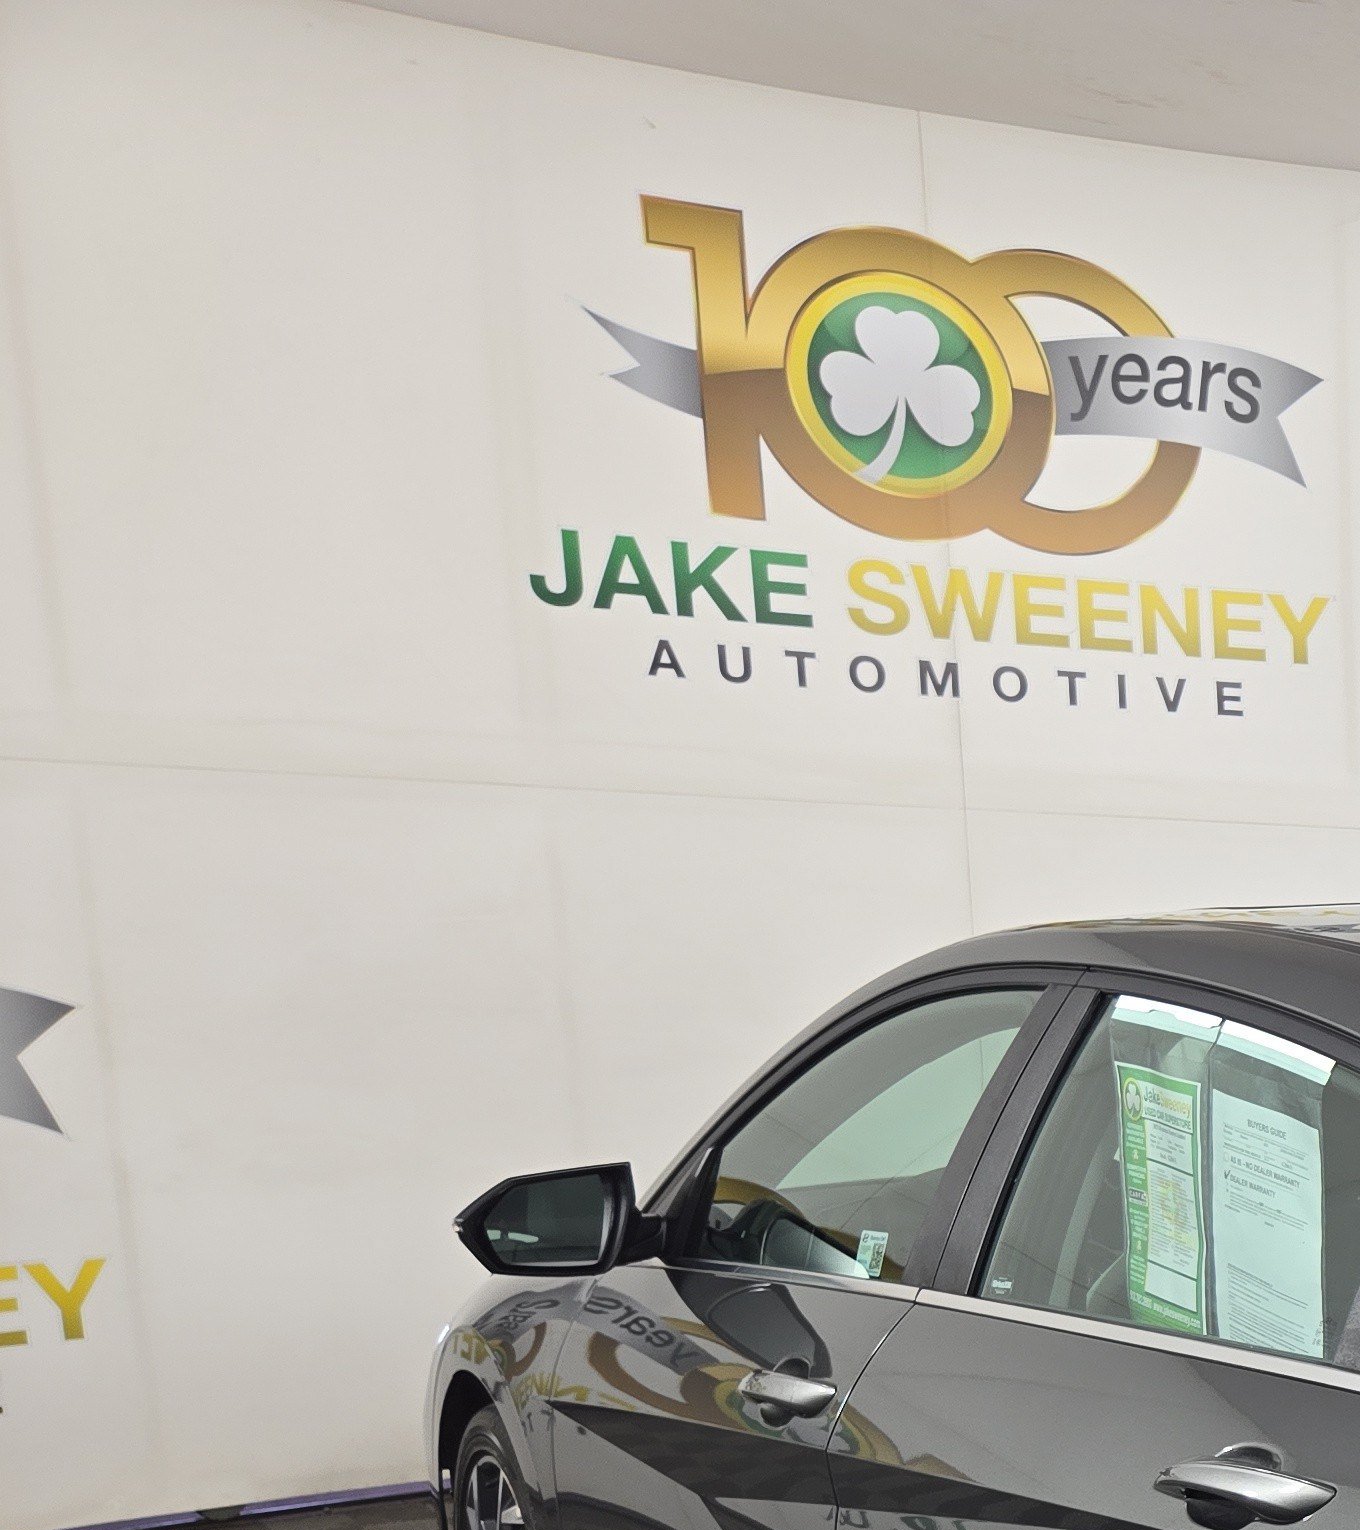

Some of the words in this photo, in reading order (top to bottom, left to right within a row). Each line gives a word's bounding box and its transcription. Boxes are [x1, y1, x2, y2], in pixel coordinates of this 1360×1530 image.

[640, 194, 1203, 556] 100
[1067, 351, 1263, 425] years
[529, 529, 814, 628] JAKE
[846, 559, 1328, 665] SWEENEY
[647, 638, 1246, 718] AUTOMOTIVE
